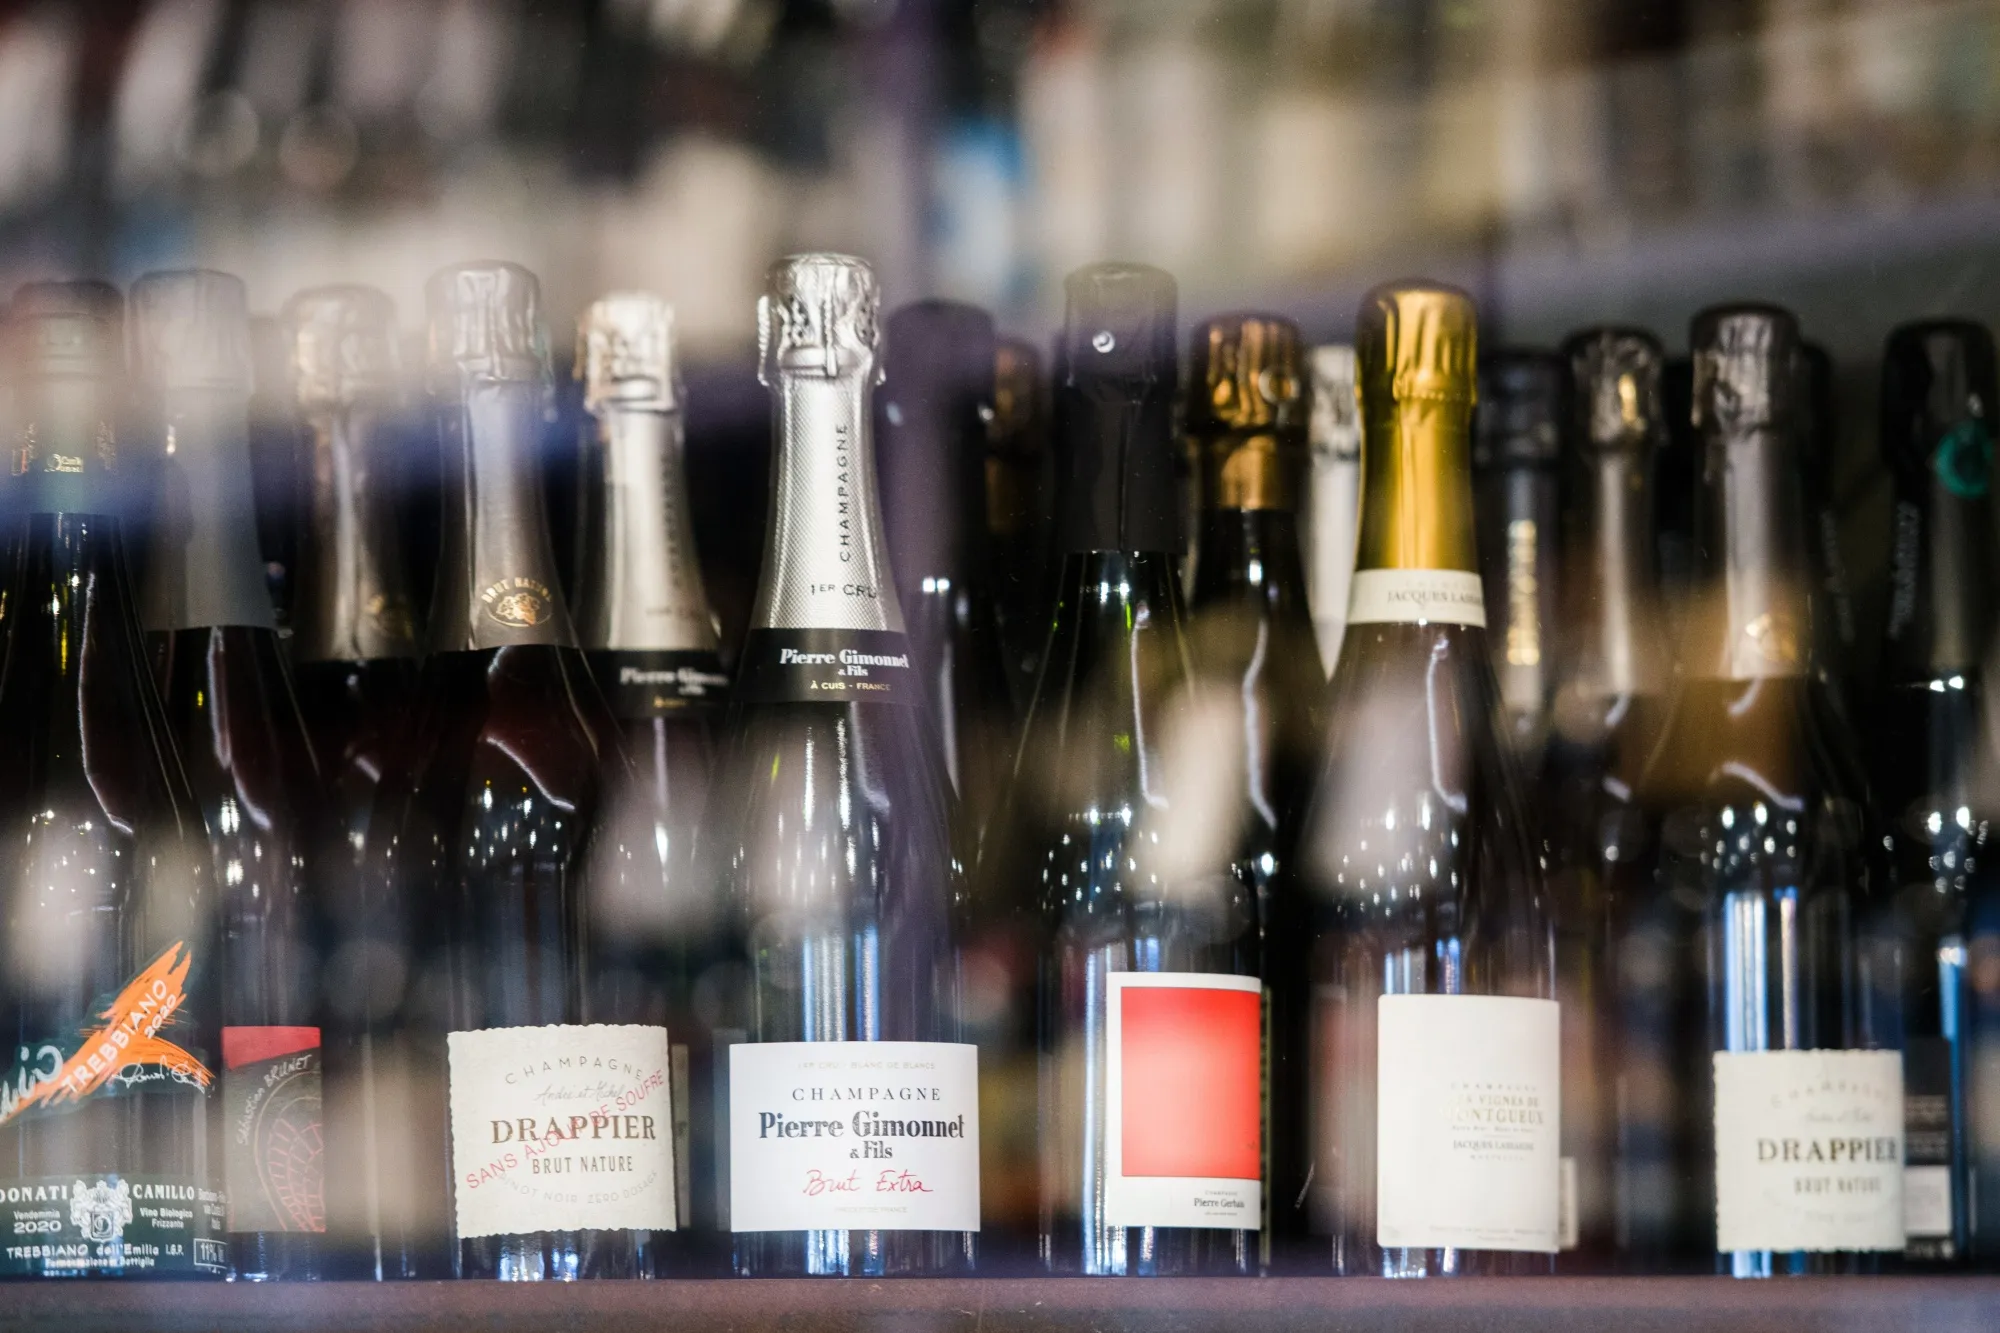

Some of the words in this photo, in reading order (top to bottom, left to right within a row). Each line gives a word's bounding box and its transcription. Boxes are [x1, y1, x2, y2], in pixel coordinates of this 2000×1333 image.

[835, 424, 851, 563] CHAMPAGNE
[780, 648, 837, 665] Pierre
[838, 648, 910, 669] Gimonnet
[846, 664, 869, 677] Fils
[821, 681, 846, 690] CUIS
[856, 682, 892, 691] FRANCE
[143, 993, 178, 1040] 2020
[61, 979, 167, 1093] TREBBIANO
[264, 1054, 313, 1088] BRUNET
[504, 1055, 643, 1086] CHAMPAGNE
[791, 1086, 942, 1101] CHAMPAGNE
[465, 1152, 519, 1190] SANS
[615, 1069, 665, 1112] SOUFRE
[489, 1115, 657, 1145] DRAPPIER
[758, 1111, 844, 1139] Pierre
[851, 1110, 965, 1139] Gimonnet
[849, 1147, 860, 1159] &
[862, 1140, 894, 1159] Fils
[532, 1156, 572, 1175] BRUT
[580, 1155, 633, 1173] NATURE
[132, 1183, 195, 1201] CAMILLO
[802, 1168, 861, 1197] Brut
[875, 1168, 934, 1194] Extra
[543, 1190, 578, 1204] NOIR
[1193, 1197, 1219, 1208] Pierre
[140, 1207, 159, 1218] Vino
[13, 1219, 62, 1234] 2020
[6, 1243, 89, 1260] TREBBIANO
